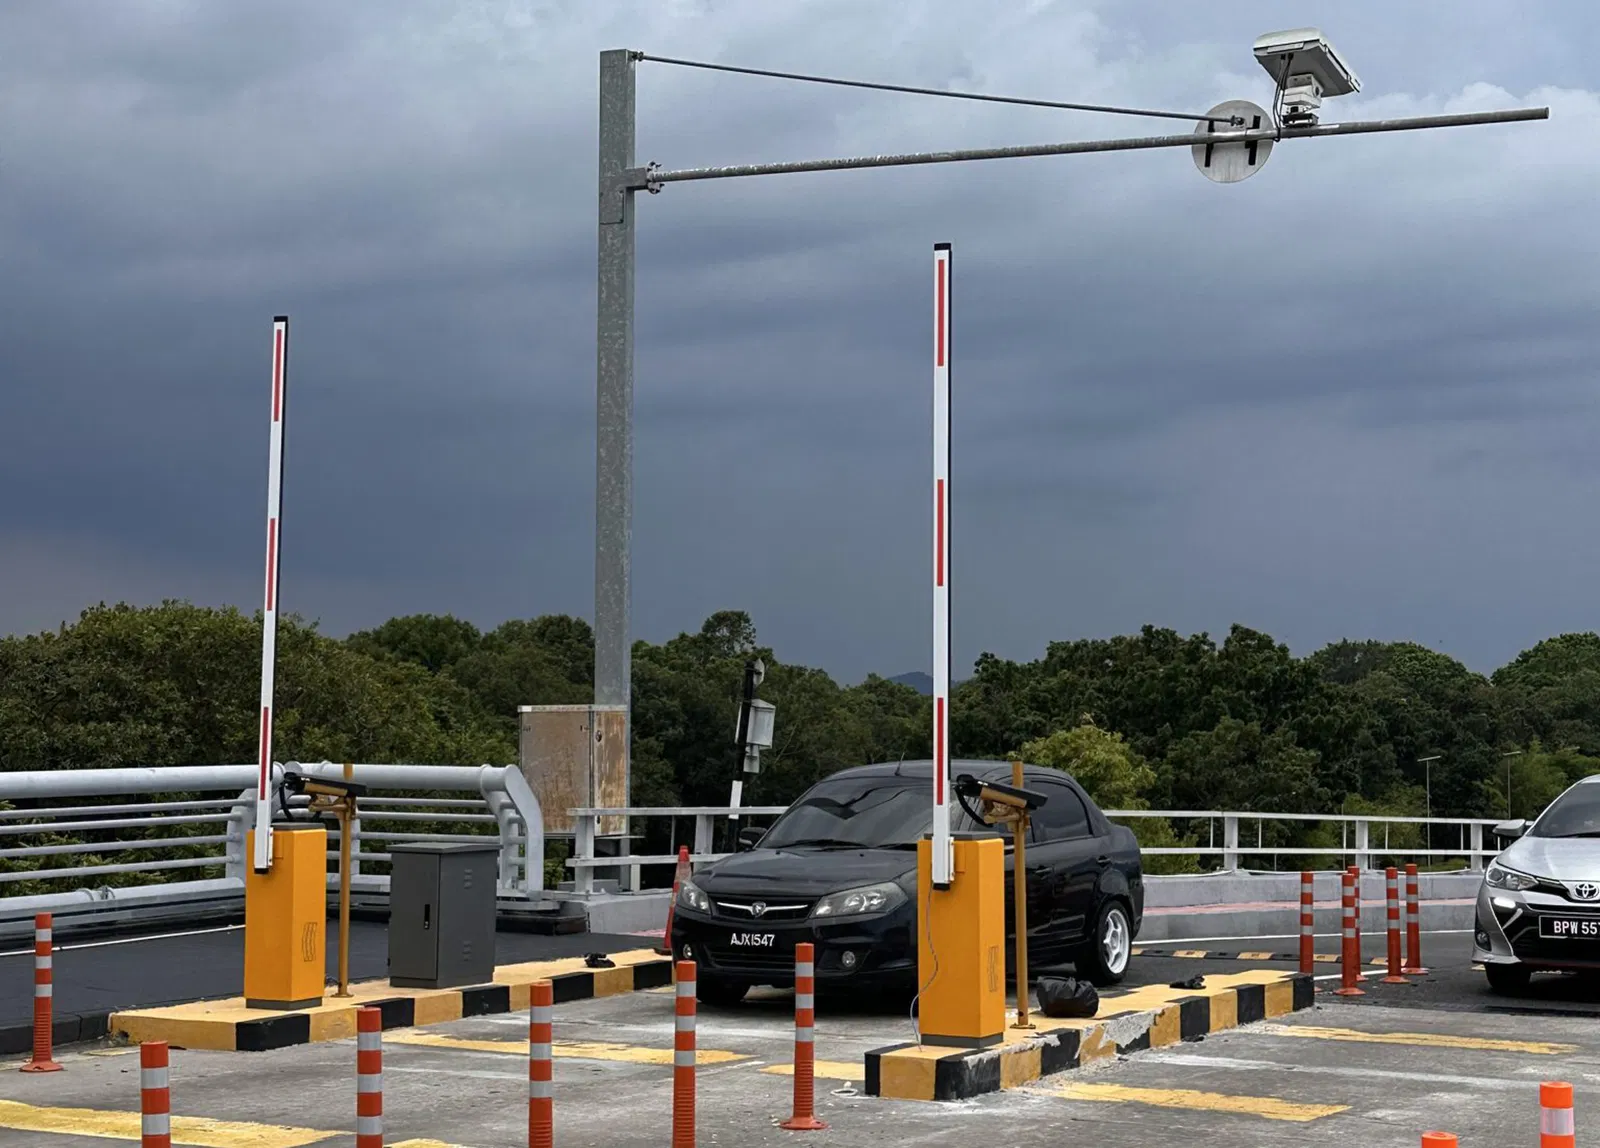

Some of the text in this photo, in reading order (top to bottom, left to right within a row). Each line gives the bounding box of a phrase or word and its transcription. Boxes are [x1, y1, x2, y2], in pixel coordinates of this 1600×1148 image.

[1553, 921, 1600, 935] BPW 55
[730, 933, 775, 947] AJX1547
